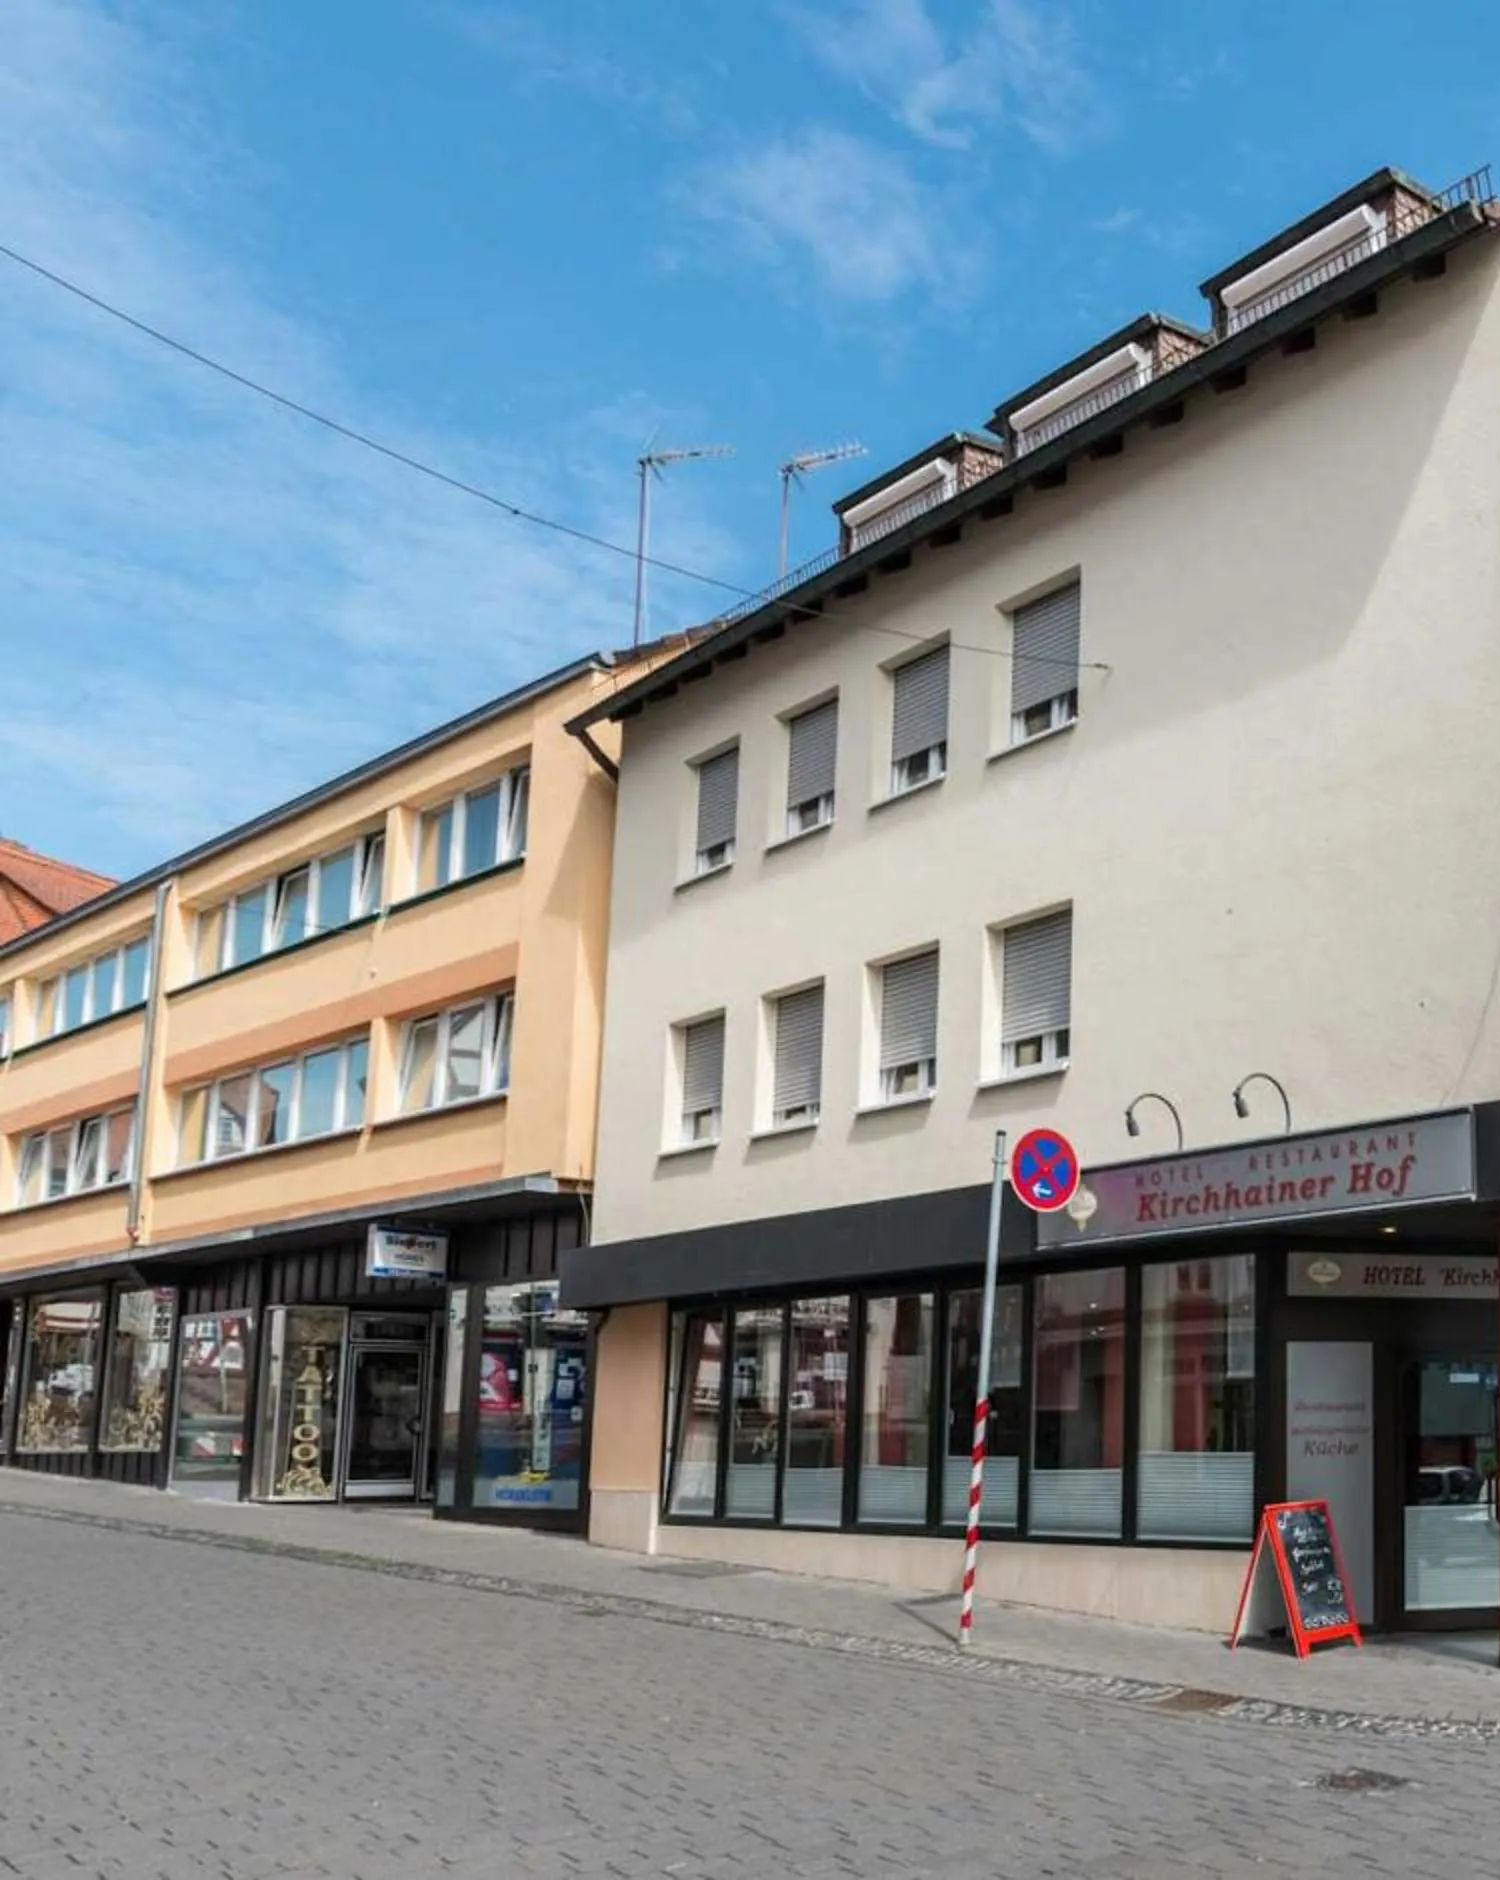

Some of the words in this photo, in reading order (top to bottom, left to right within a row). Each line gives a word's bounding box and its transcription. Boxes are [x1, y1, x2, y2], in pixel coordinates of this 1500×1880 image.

[1134, 1165, 1204, 1188] HOTEL
[1248, 1131, 1417, 1172] RESTAURANT
[1136, 1173, 1336, 1223] Kirchhainer
[1347, 1153, 1417, 1197] Hof
[1363, 1265, 1425, 1287] HOTEL
[292, 1345, 326, 1462] TATTOO
